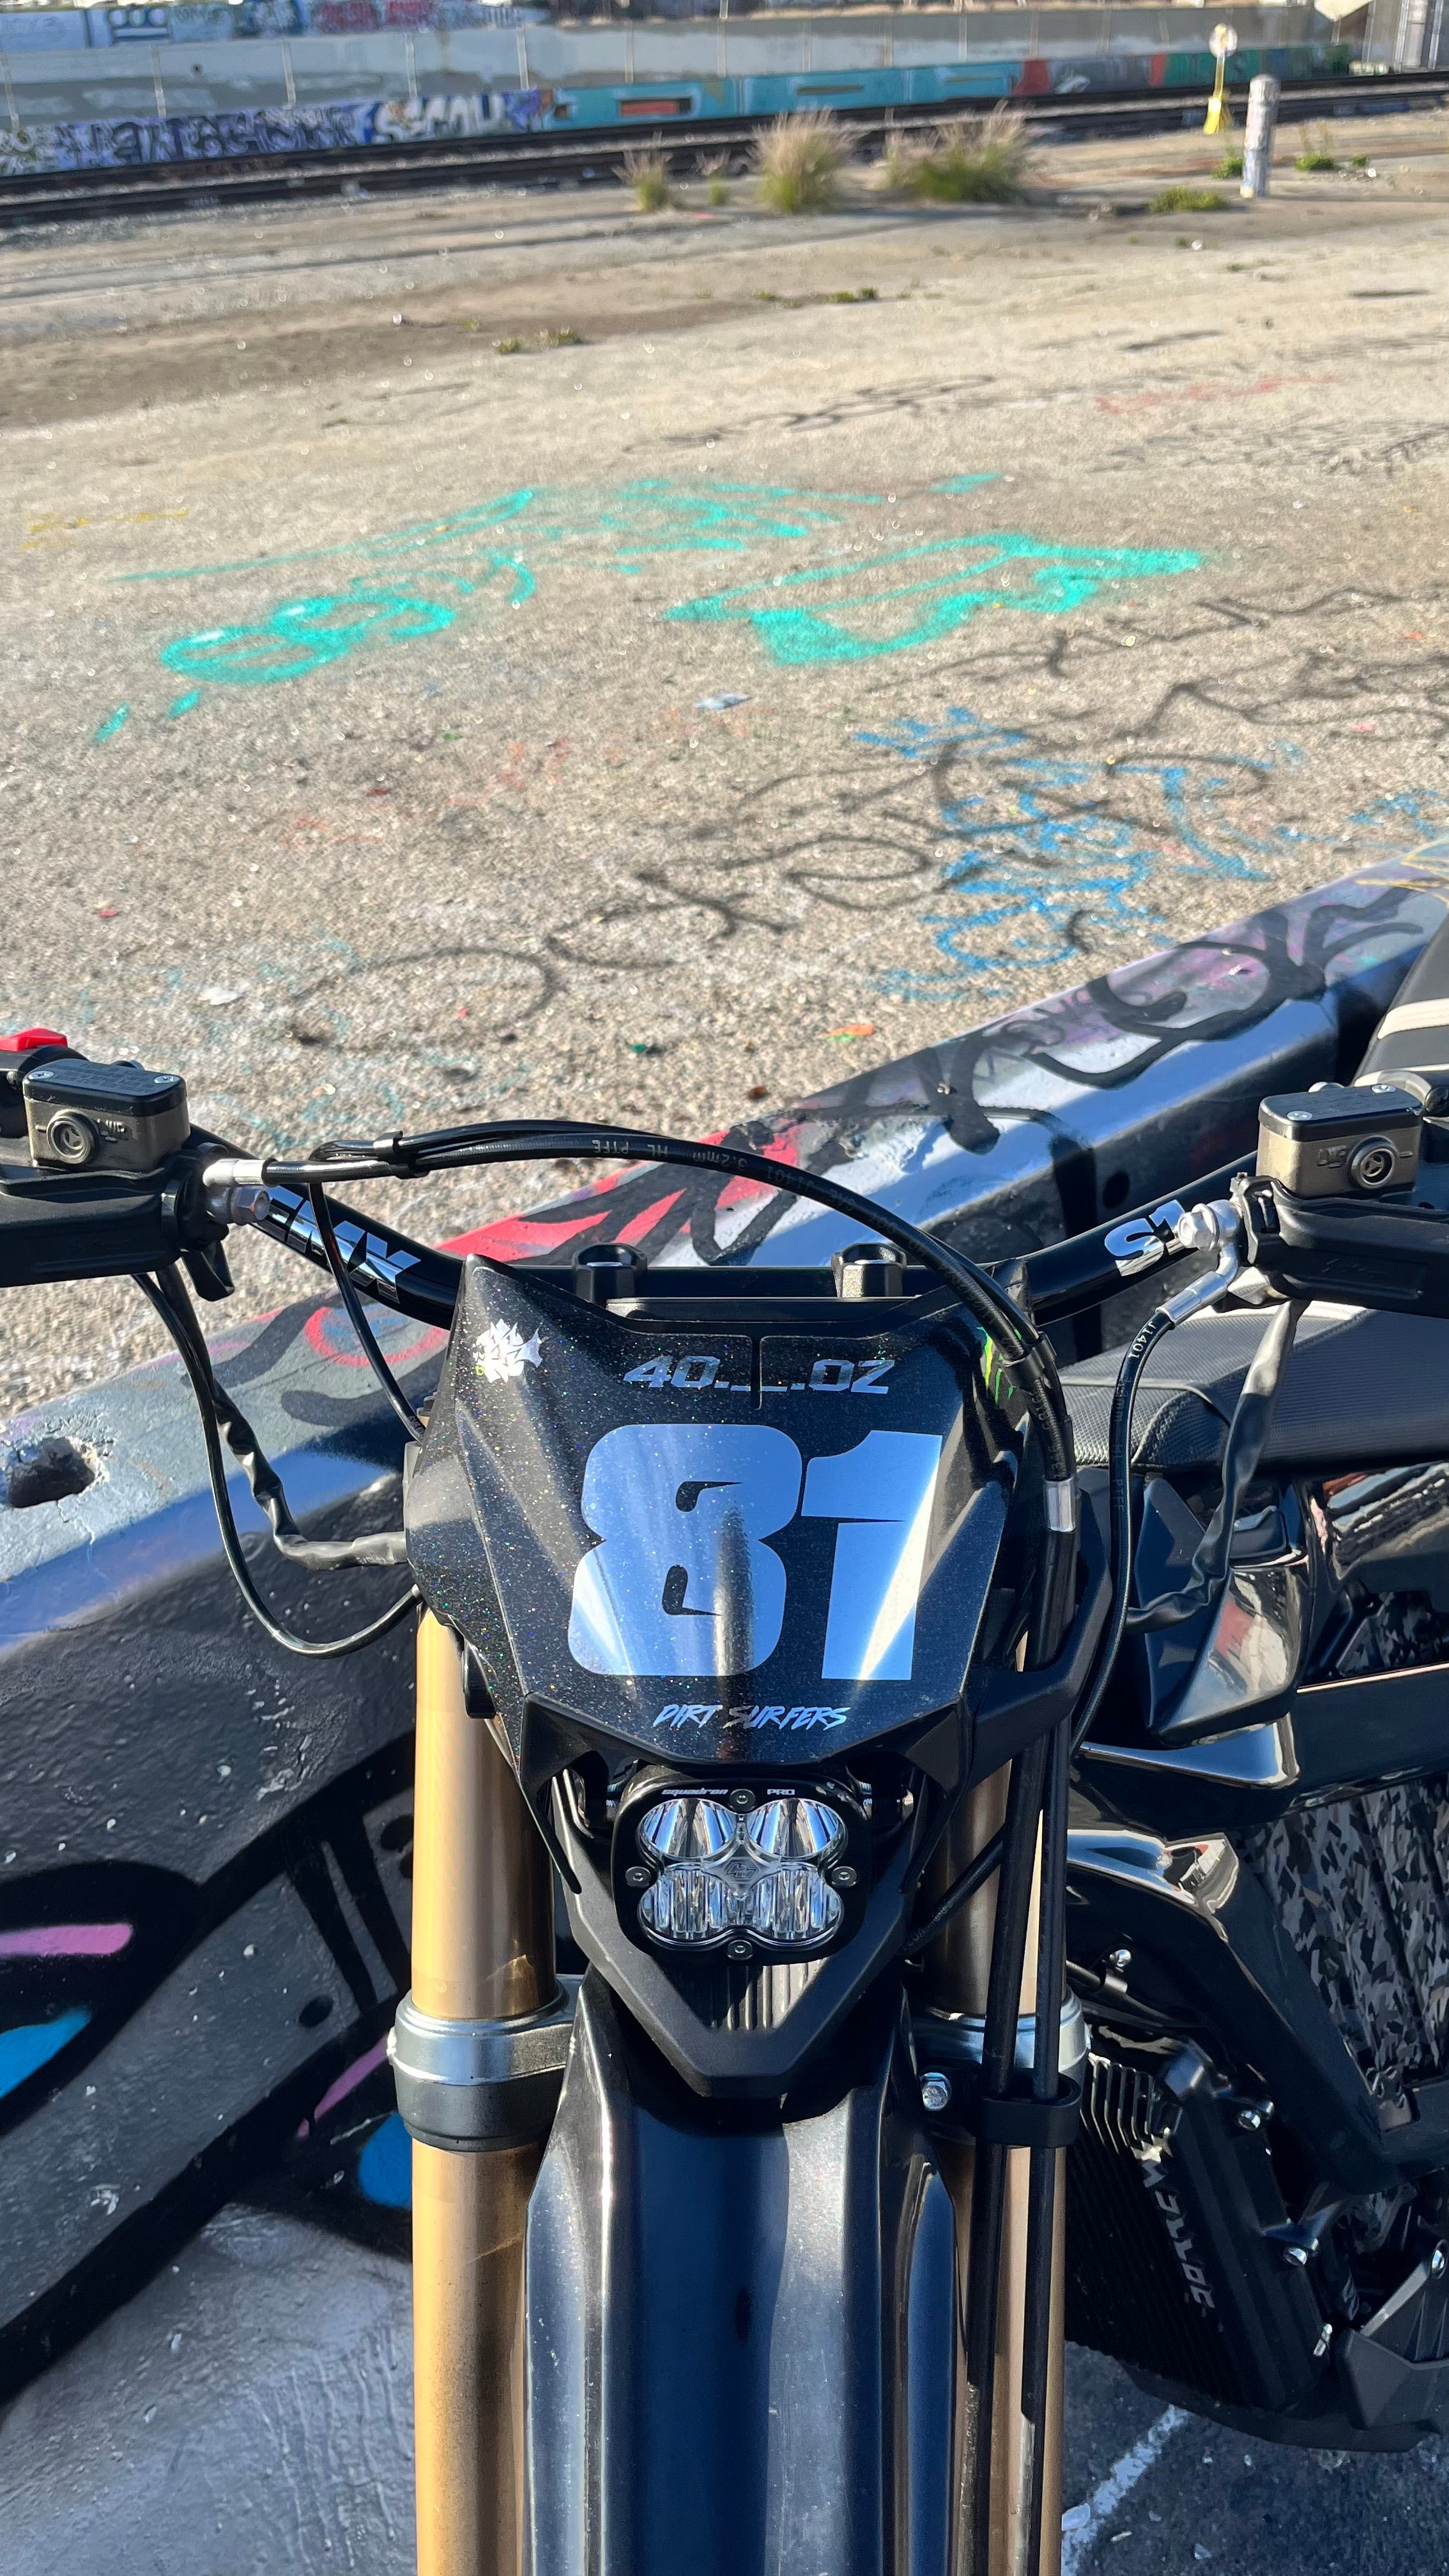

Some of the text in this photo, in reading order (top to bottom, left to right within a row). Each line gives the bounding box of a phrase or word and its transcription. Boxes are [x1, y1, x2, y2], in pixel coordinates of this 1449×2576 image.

[592, 1140, 629, 1154] PTFE
[1128, 1321, 1156, 1359] J1401
[567, 1423, 943, 1680] 81
[653, 1704, 851, 1731] DIRT SURFERS
